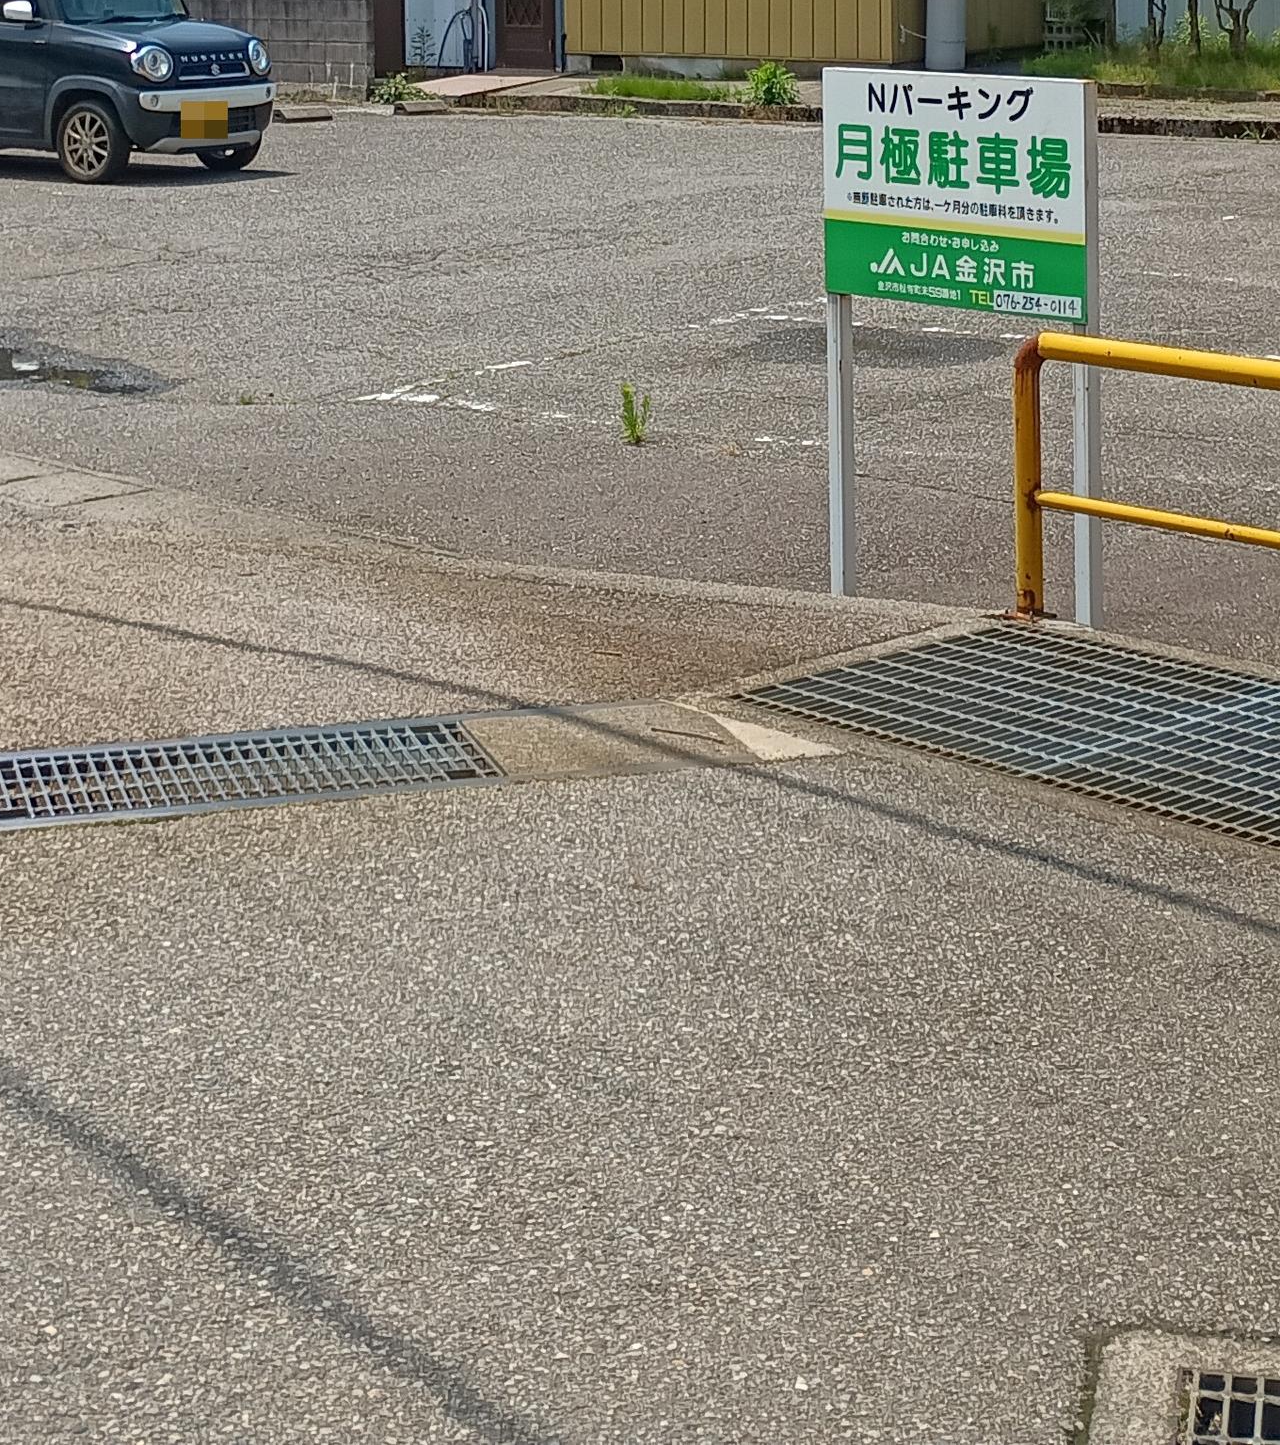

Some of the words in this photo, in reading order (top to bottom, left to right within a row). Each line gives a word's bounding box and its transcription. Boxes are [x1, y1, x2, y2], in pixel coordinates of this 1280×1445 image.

[868, 82, 1034, 122] Nパーキング
[835, 123, 1072, 199] 月極駐車場
[909, 252, 1035, 290] JA金沢市
[969, 289, 994, 306] TEL
[995, 293, 1078, 316] 076-254-0114
